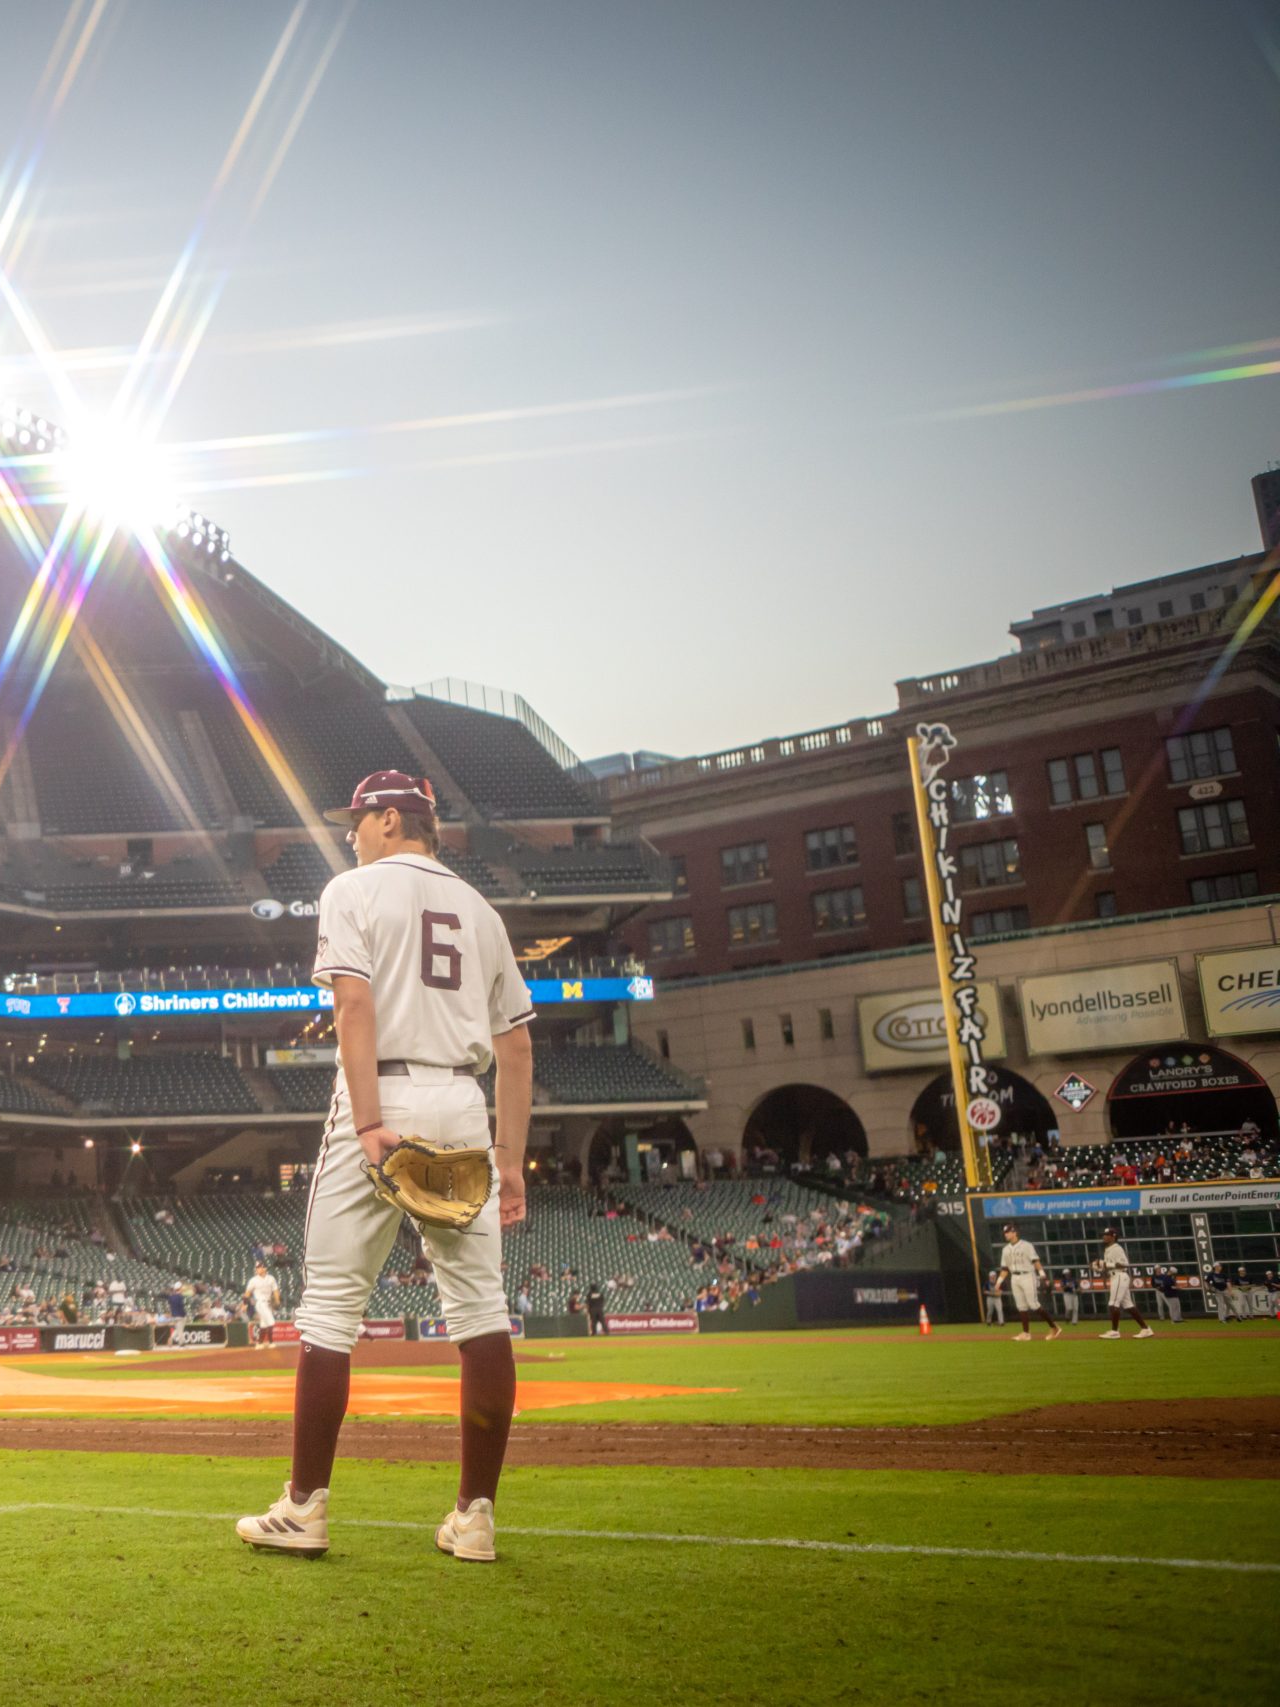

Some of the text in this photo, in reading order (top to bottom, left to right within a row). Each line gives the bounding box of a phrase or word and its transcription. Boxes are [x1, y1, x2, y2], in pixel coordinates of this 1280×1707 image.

[928, 778, 962, 924] CHIKIN
[955, 987, 988, 1094] FAIR
[420, 909, 463, 991] 6
[561, 981, 584, 999] M
[140, 994, 219, 1011] Shriners
[222, 990, 311, 1009] Children's
[1030, 983, 1173, 1022] lyondellbasell
[1149, 1064, 1213, 1078] LANDRY'S
[1130, 1075, 1239, 1093] CRAWFORD BOXES
[1023, 1196, 1131, 1211] Help protect your home
[1149, 1194, 1178, 1204] Enroll
[1180, 1193, 1189, 1202] at
[936, 1201, 965, 1215] 315
[1195, 1217, 1218, 1307] NATIOL
[54, 1329, 106, 1350] marucci
[175, 1330, 212, 1343] OORE
